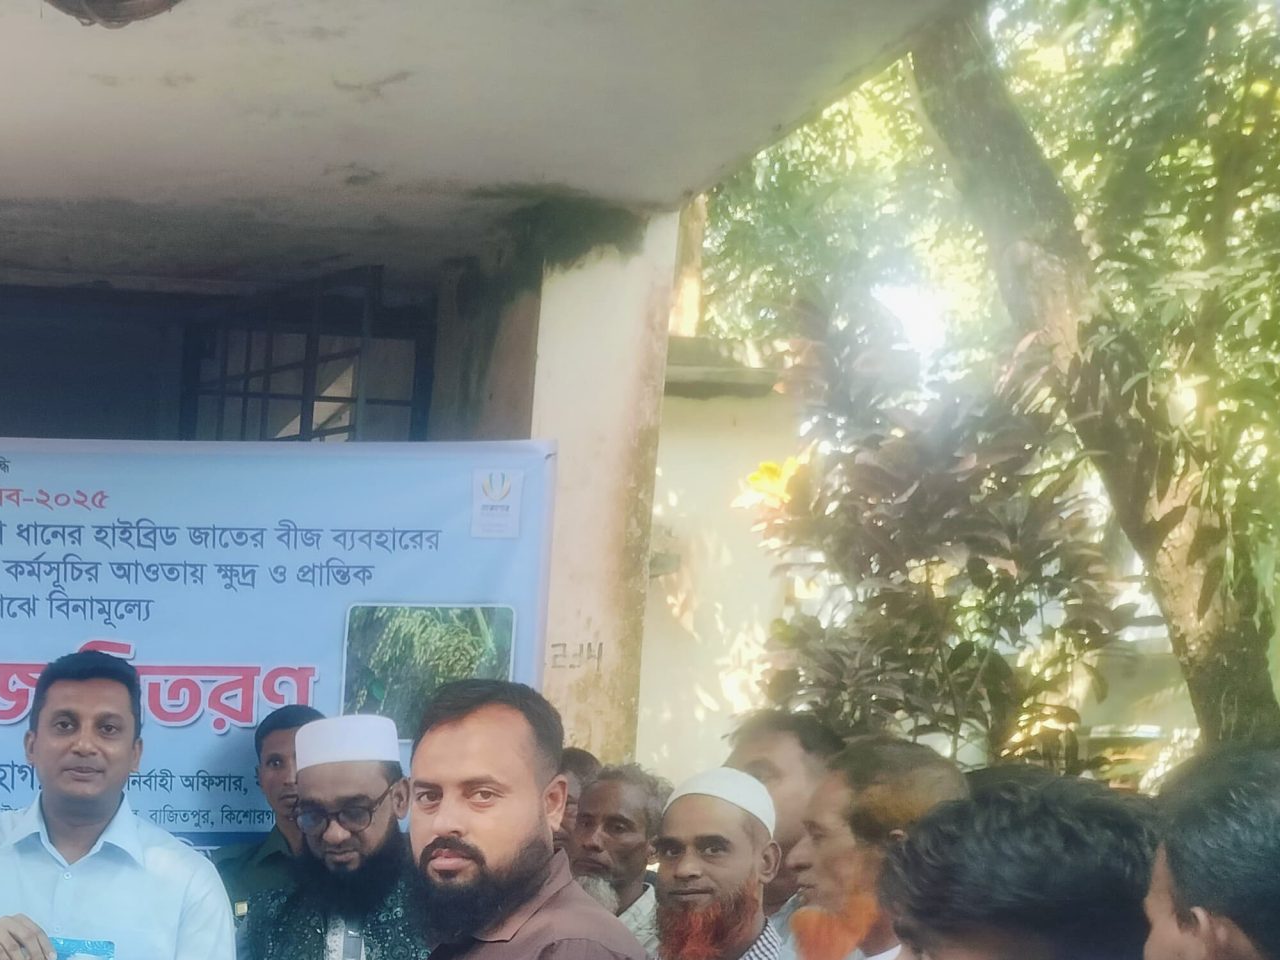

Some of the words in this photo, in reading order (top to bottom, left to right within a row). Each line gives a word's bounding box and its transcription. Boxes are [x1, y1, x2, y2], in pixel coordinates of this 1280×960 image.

[16, 521, 85, 547] ধানের
[91, 517, 181, 551] হাইব্রিড
[186, 523, 267, 550] জাতের
[273, 519, 324, 551] বীজ
[330, 527, 442, 554] ব্যবহারের
[2, 551, 102, 591] কর্মসূচির
[109, 559, 208, 587] আওতায়
[214, 563, 259, 593] ক্ষুদ্র
[267, 564, 287, 584] ও
[296, 557, 376, 588] প্রান্তিক
[46, 589, 155, 629] বিনামূল্যে
[179, 769, 249, 796] অফিসার,
[149, 804, 215, 828] বাজিতপুর,
